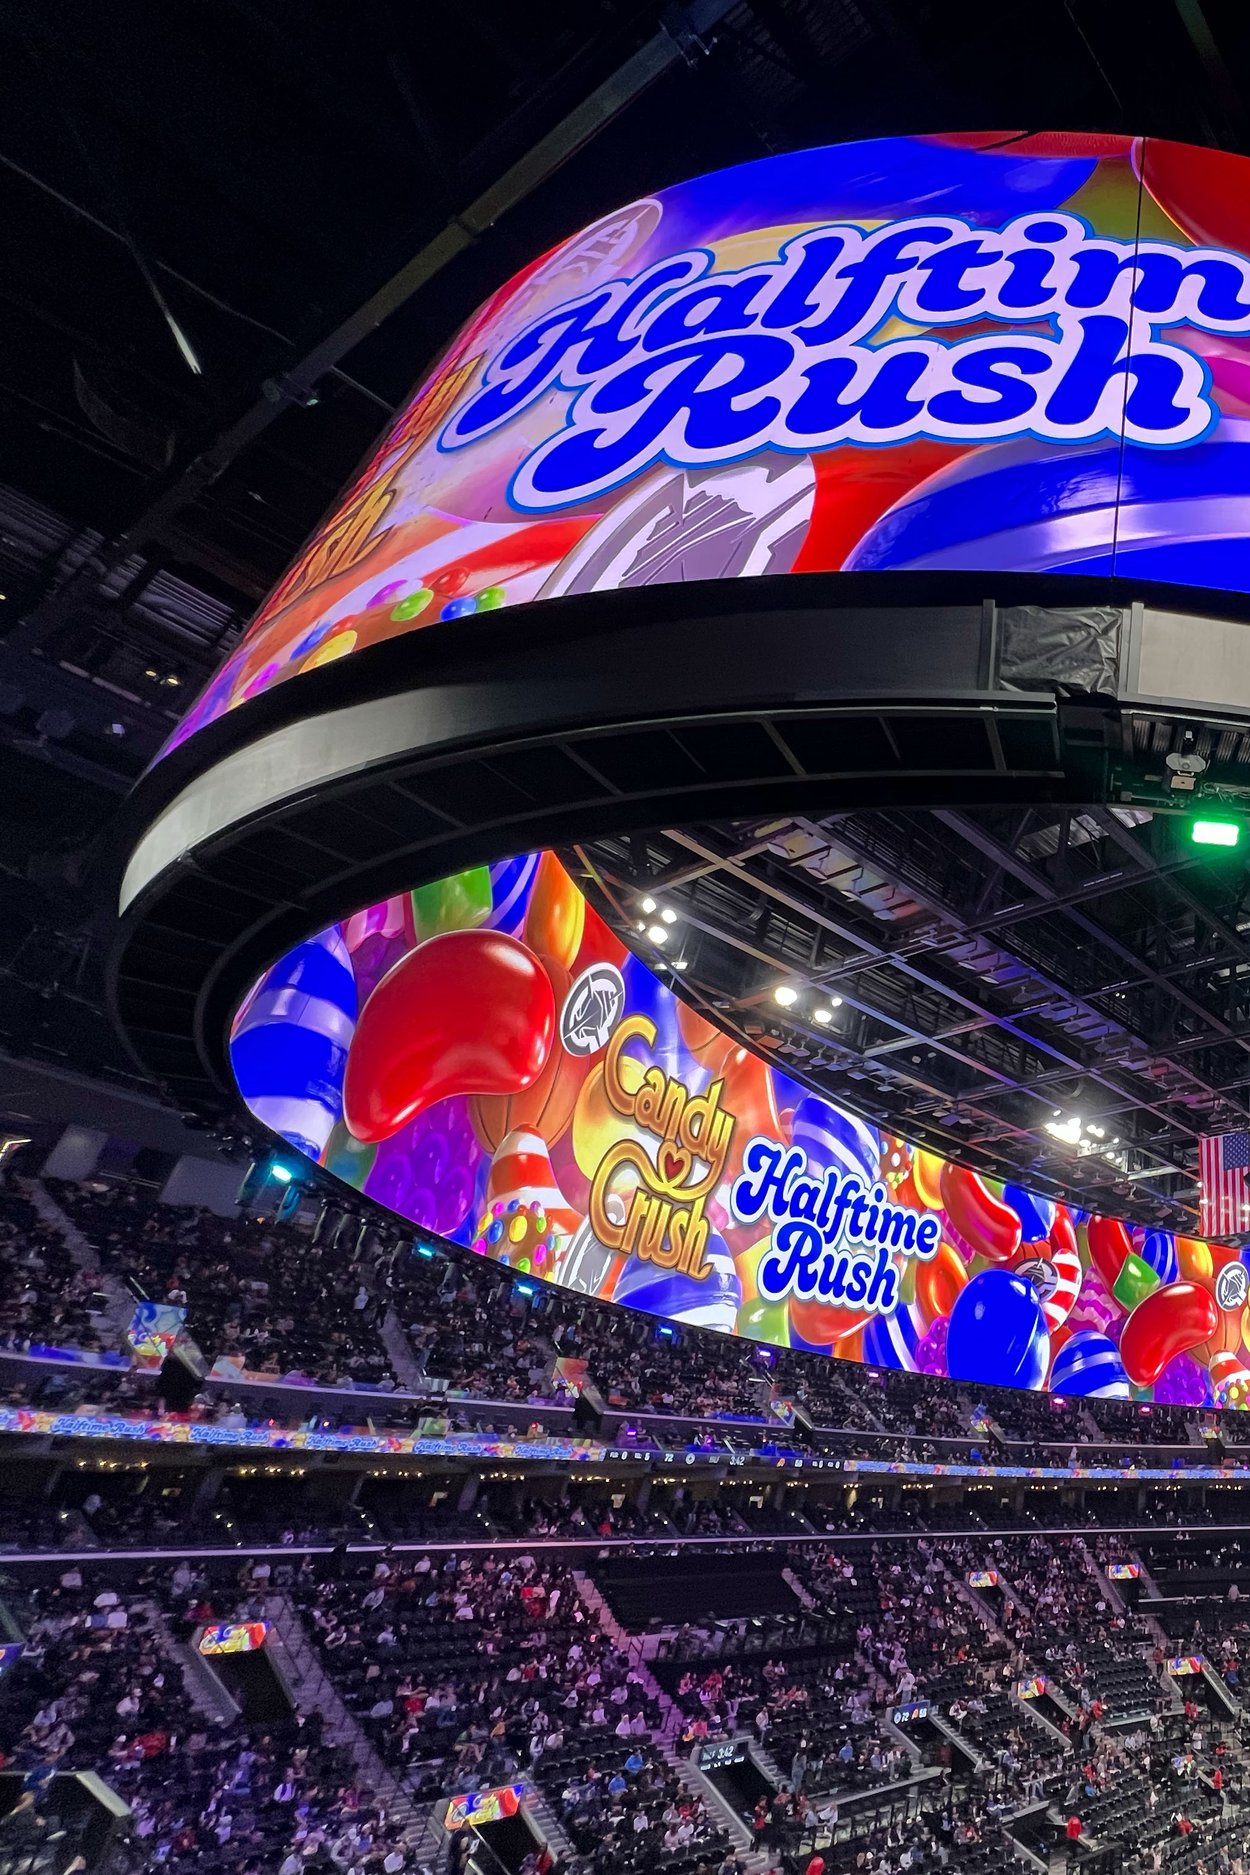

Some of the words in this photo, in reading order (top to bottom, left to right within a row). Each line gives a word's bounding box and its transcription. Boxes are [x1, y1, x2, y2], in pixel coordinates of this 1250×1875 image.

[516, 312, 1206, 499] Rush
[603, 1014, 736, 1188] Candy
[589, 1139, 714, 1280] Crush
[734, 1140, 940, 1254] Halftime
[761, 1221, 898, 1308] Rush
[54, 1418, 110, 1433] Halftime
[111, 1421, 145, 1434] Rush
[190, 1427, 238, 1441] Halftime
